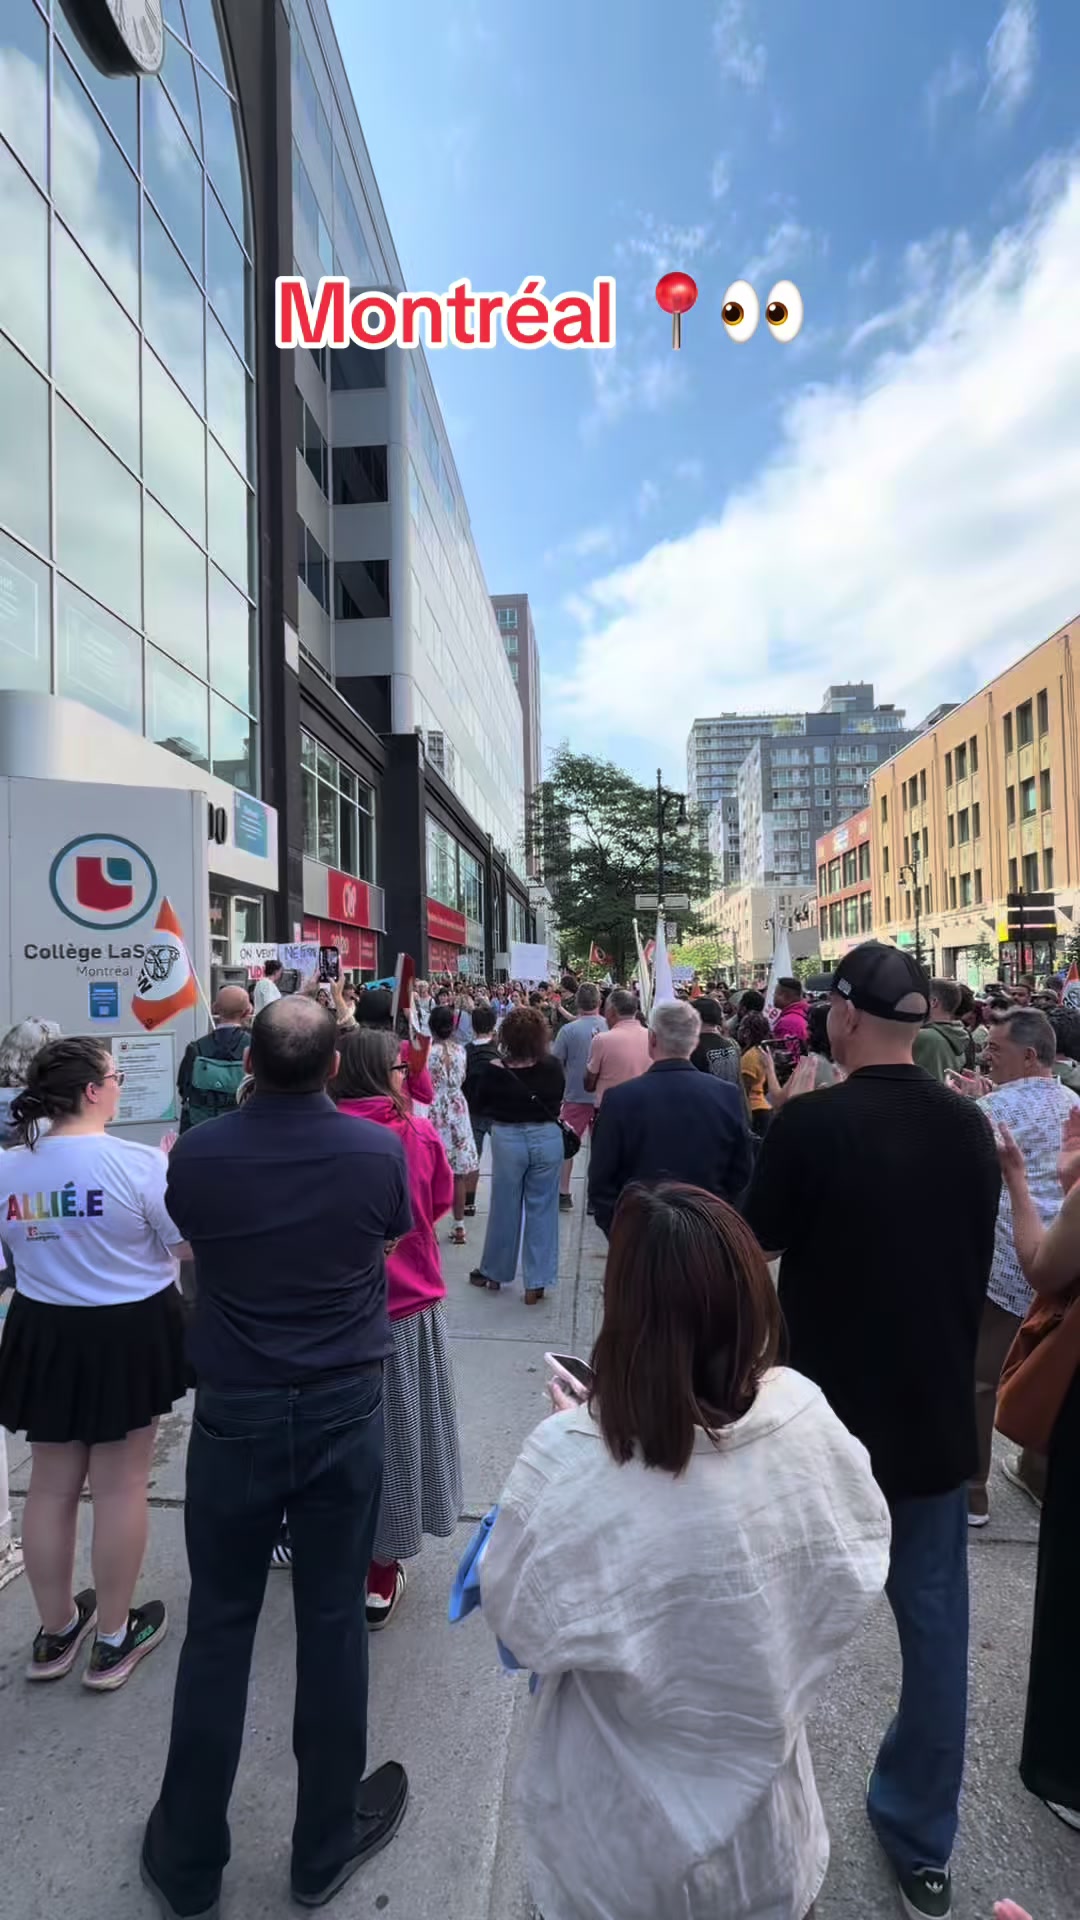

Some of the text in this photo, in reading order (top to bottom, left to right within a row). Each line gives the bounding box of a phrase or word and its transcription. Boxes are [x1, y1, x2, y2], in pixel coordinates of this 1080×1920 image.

[24, 943, 145, 962] Collège LaS
[76, 966, 133, 977] Montréal
[7, 1181, 104, 1220] ALLIÉ.E
